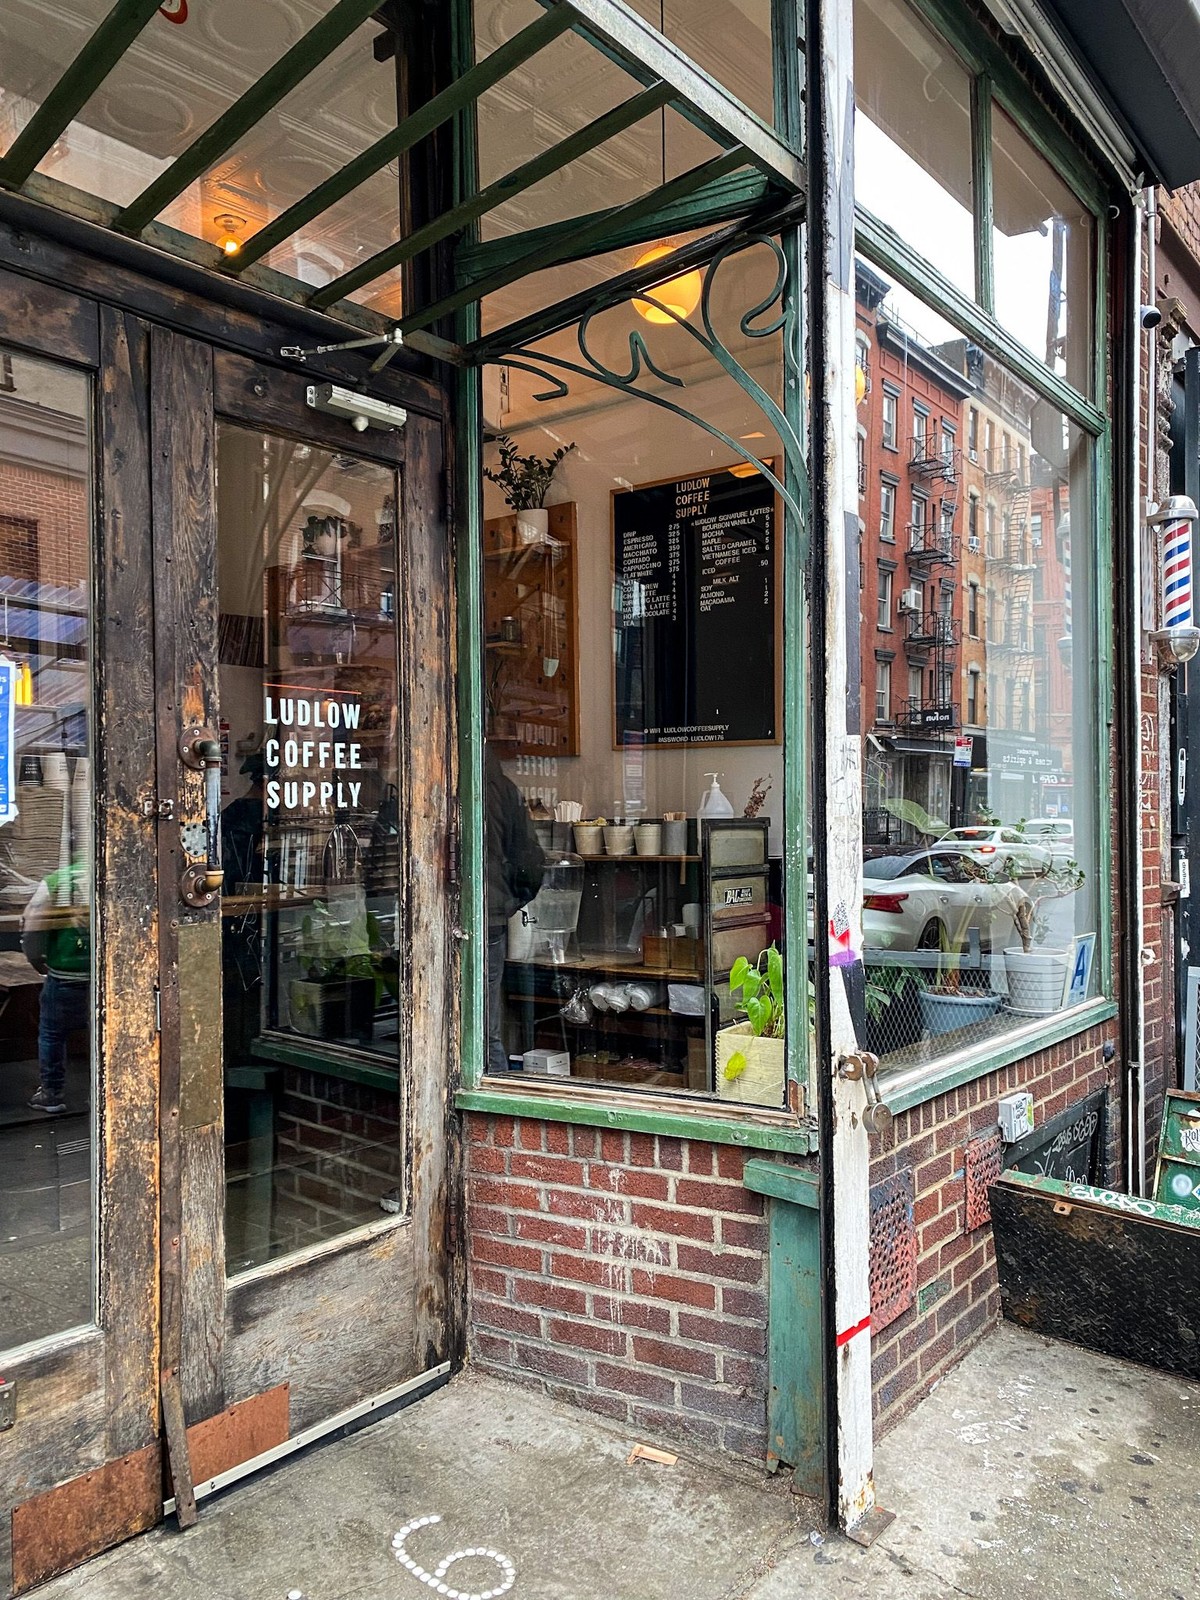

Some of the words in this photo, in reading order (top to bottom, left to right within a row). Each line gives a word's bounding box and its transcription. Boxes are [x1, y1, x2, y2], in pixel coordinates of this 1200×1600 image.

[676, 477, 710, 493] LUDLOW
[675, 490, 710, 506] COFFEE
[675, 504, 708, 518] SUPPLY
[750, 506, 770, 516] LATTES
[702, 522, 730, 532] BOURBON
[730, 517, 755, 526] VANILLA
[702, 529, 724, 538] MOCHA
[623, 535, 654, 545] ESPRESSO
[702, 538, 721, 546] MAPLE
[623, 541, 657, 552] AMERICANO
[702, 544, 726, 553] SALTED
[727, 539, 756, 549] CARAMEL
[623, 548, 657, 558] MACCHIATO
[702, 549, 740, 560] VIETNAMESE
[742, 546, 757, 554] ICED
[623, 556, 650, 565] CORTADO
[715, 556, 740, 566] COFFEE
[623, 562, 662, 572] CAPPUCCINO
[702, 567, 716, 575] ICED
[728, 575, 740, 583] ALT
[652, 595, 670, 603] LATTE
[700, 591, 724, 599] ALMOND
[650, 602, 670, 610] LATTE
[700, 596, 735, 606] MACADAMIA
[265, 697, 360, 729] LUDLOW
[266, 739, 362, 769] COFFEE
[266, 780, 362, 809] SUPPLY
[1070, 945, 1086, 990] A
